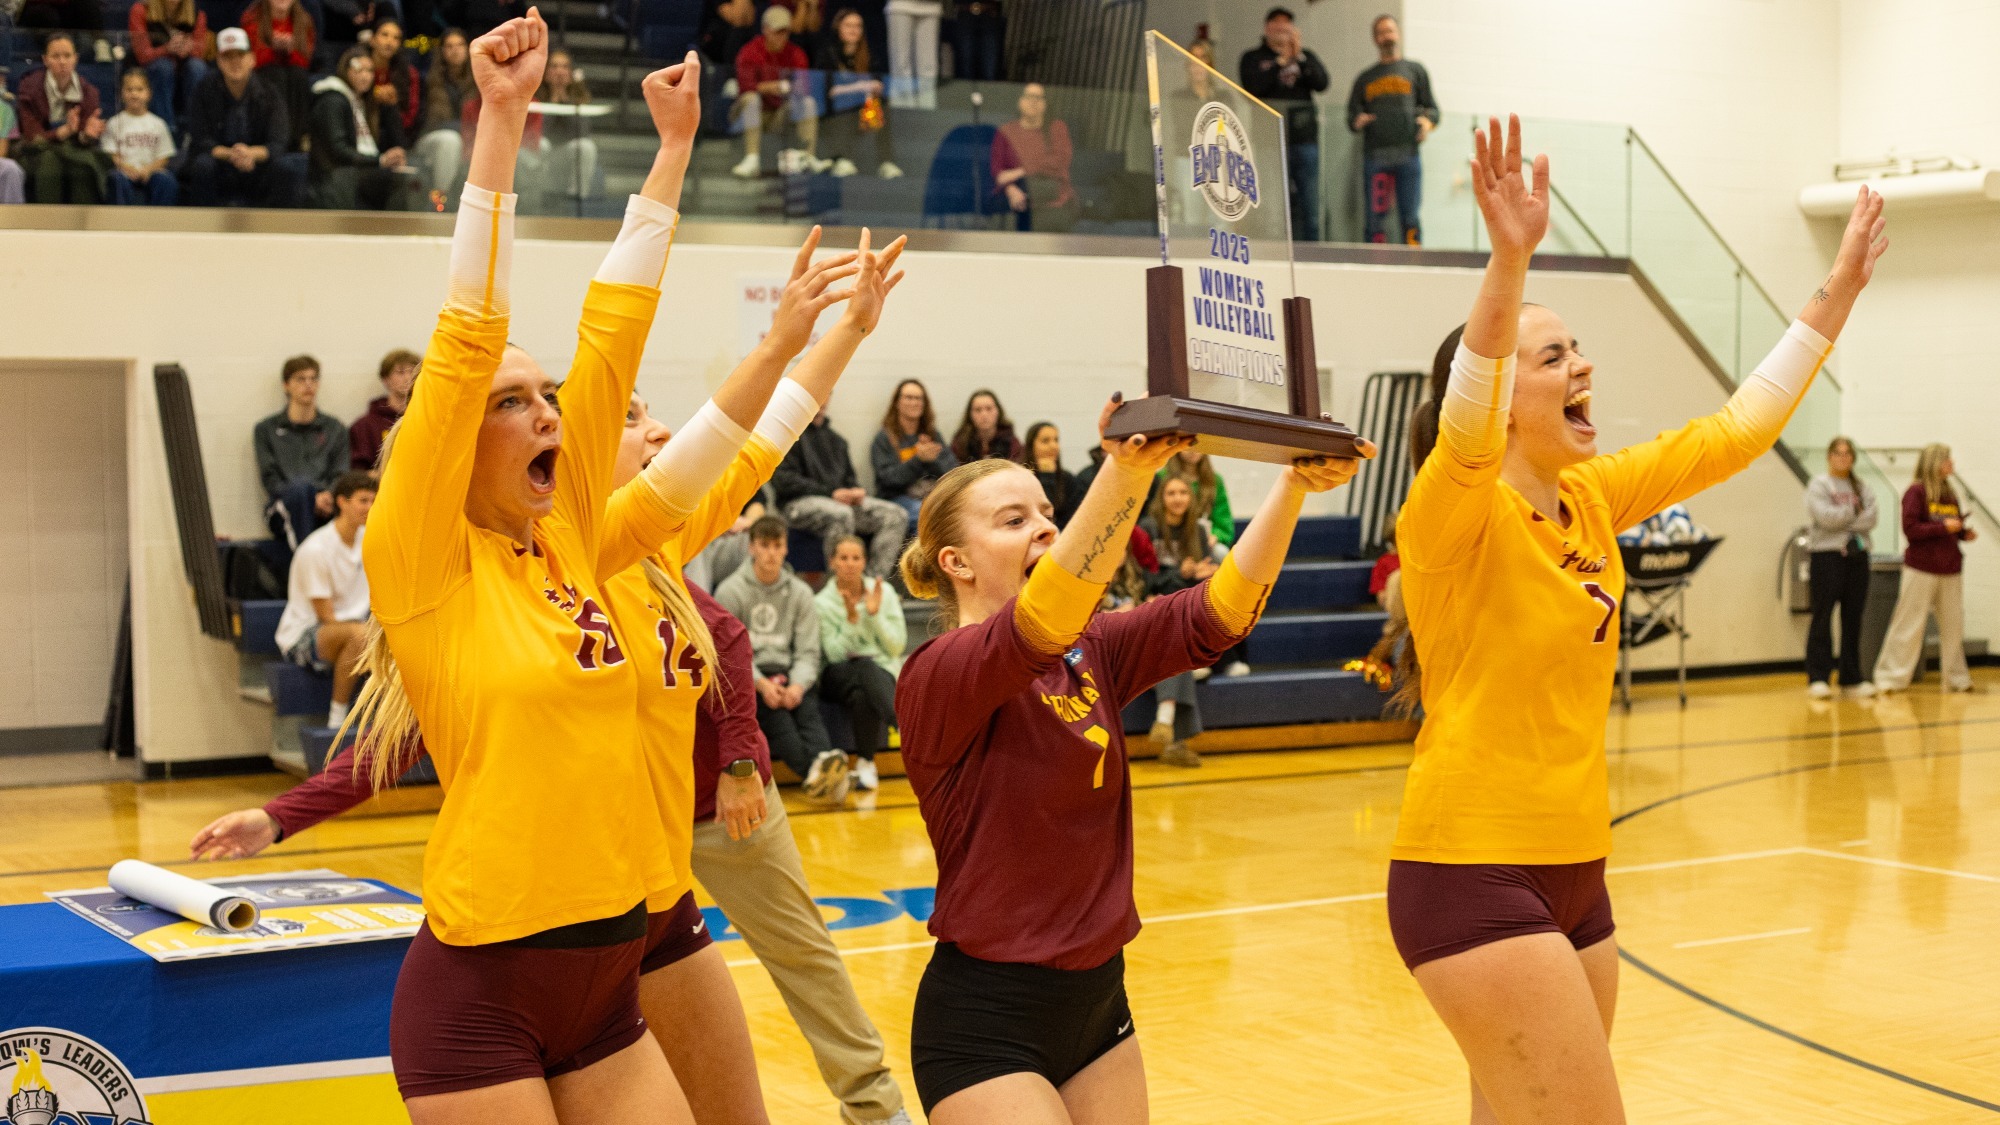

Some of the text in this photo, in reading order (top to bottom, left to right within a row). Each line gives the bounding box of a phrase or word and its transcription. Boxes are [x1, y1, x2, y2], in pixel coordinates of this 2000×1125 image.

[1210, 228, 1249, 264] 2025
[1199, 266, 1264, 308] WOMEN'S
[1193, 297, 1274, 340] VOLLEYBALL
[1190, 338, 1285, 386] CHAMPIONS
[1580, 582, 1617, 644] 7
[1083, 724, 1110, 790] 7
[0, 1038, 129, 1103] OW'S LEADERS
